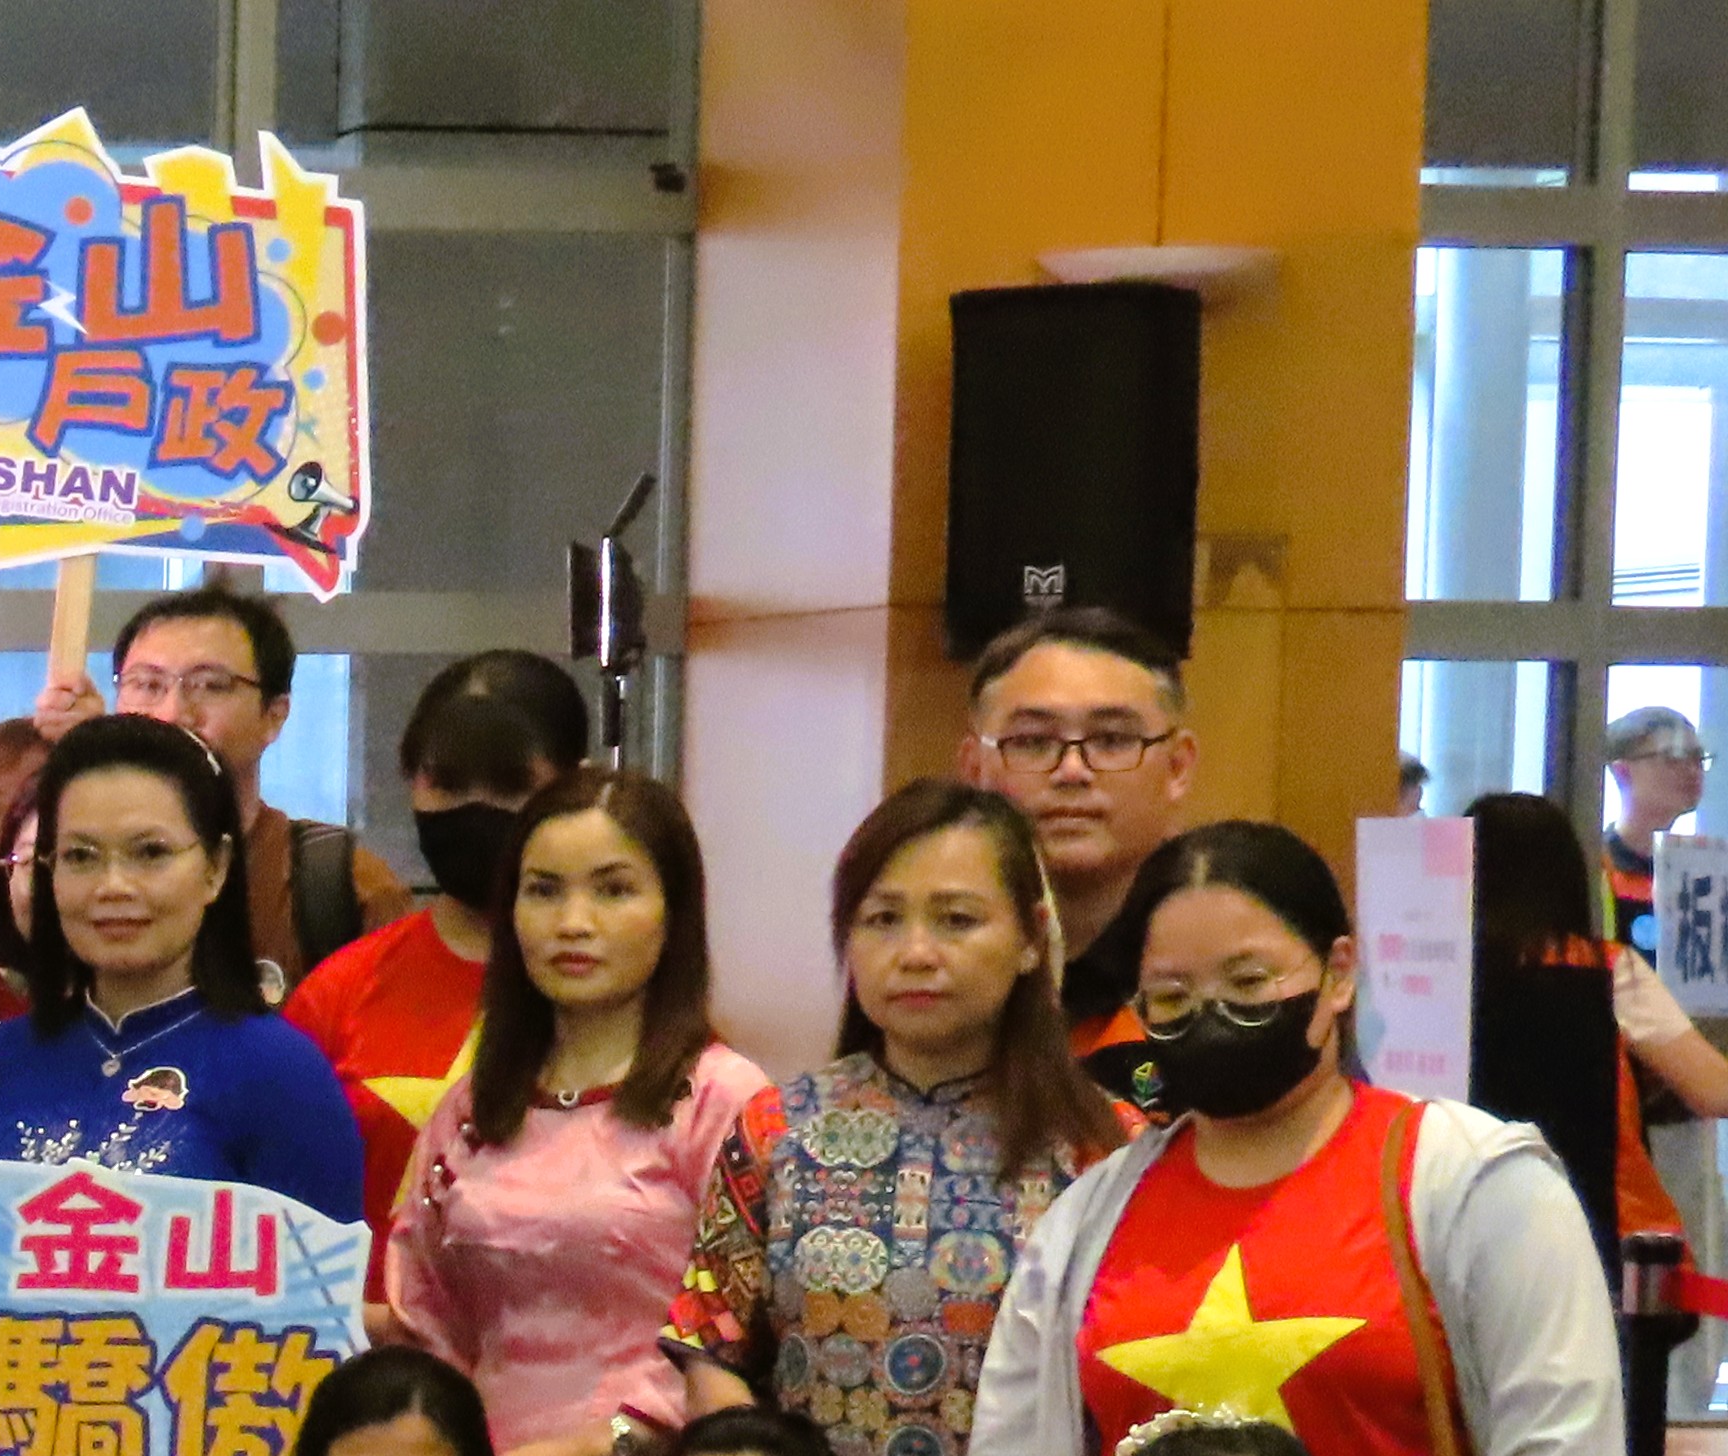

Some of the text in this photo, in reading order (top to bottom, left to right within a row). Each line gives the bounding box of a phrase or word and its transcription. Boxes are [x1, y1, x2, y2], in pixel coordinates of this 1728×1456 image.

[83, 506, 134, 524] Office
[1675, 870, 1728, 983] 板
[16, 1171, 278, 1296] 金山
